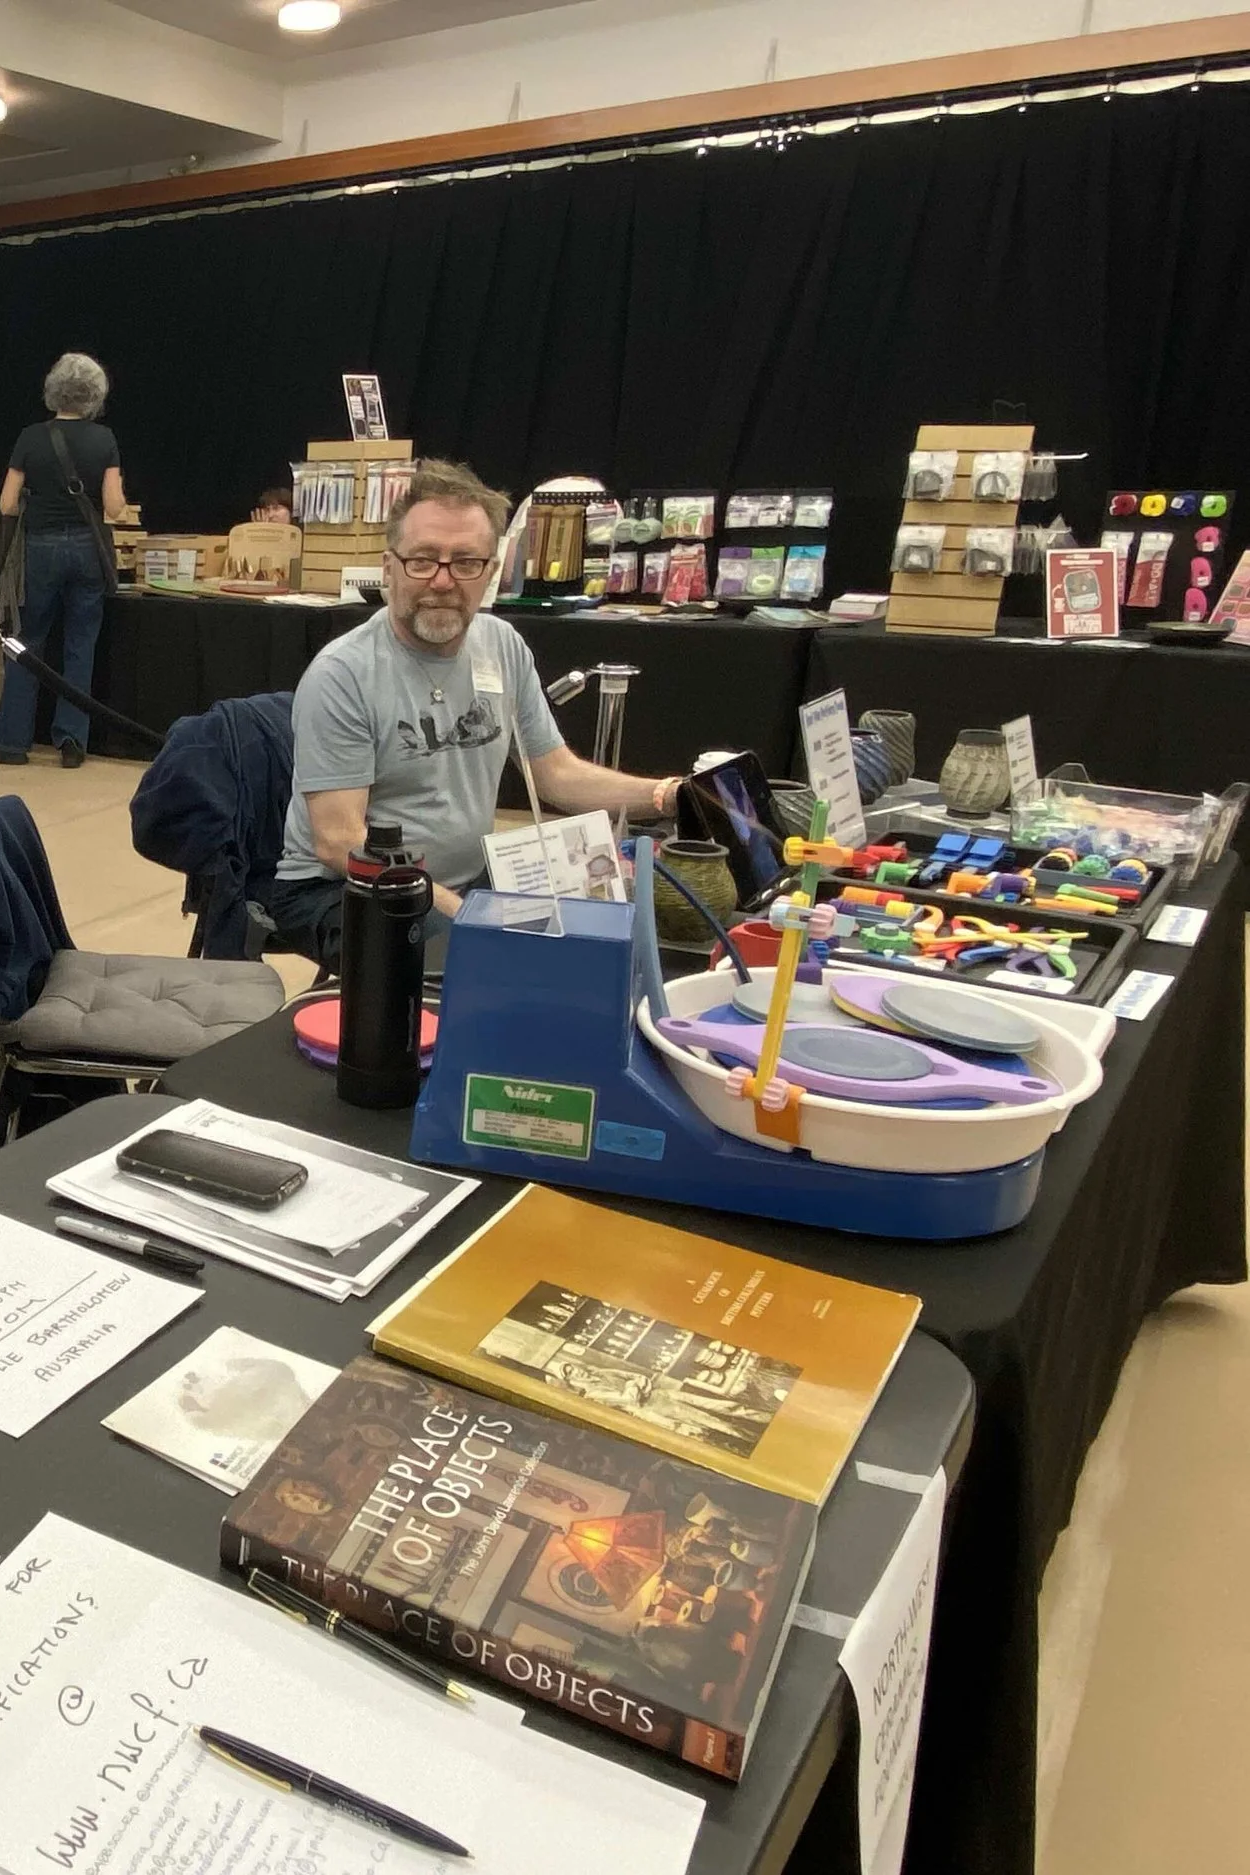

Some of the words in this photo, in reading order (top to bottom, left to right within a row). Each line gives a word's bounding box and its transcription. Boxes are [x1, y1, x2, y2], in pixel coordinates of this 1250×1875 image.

[26, 1272, 132, 1346] BARTHOLOMEW
[34, 1322, 118, 1382] AUSTRALIA
[348, 1479, 416, 1537] THE
[387, 1405, 468, 1485] PLACE
[392, 1516, 442, 1565] OF
[421, 1415, 513, 1519] OBJECTS
[5, 1557, 52, 1594] FOR
[459, 1554, 475, 1578] The
[471, 1531, 493, 1560] John
[482, 1505, 508, 1537] David
[58, 1685, 95, 1726] @
[451, 1630, 497, 1666] OF
[505, 1652, 655, 1733] OBJECTS
